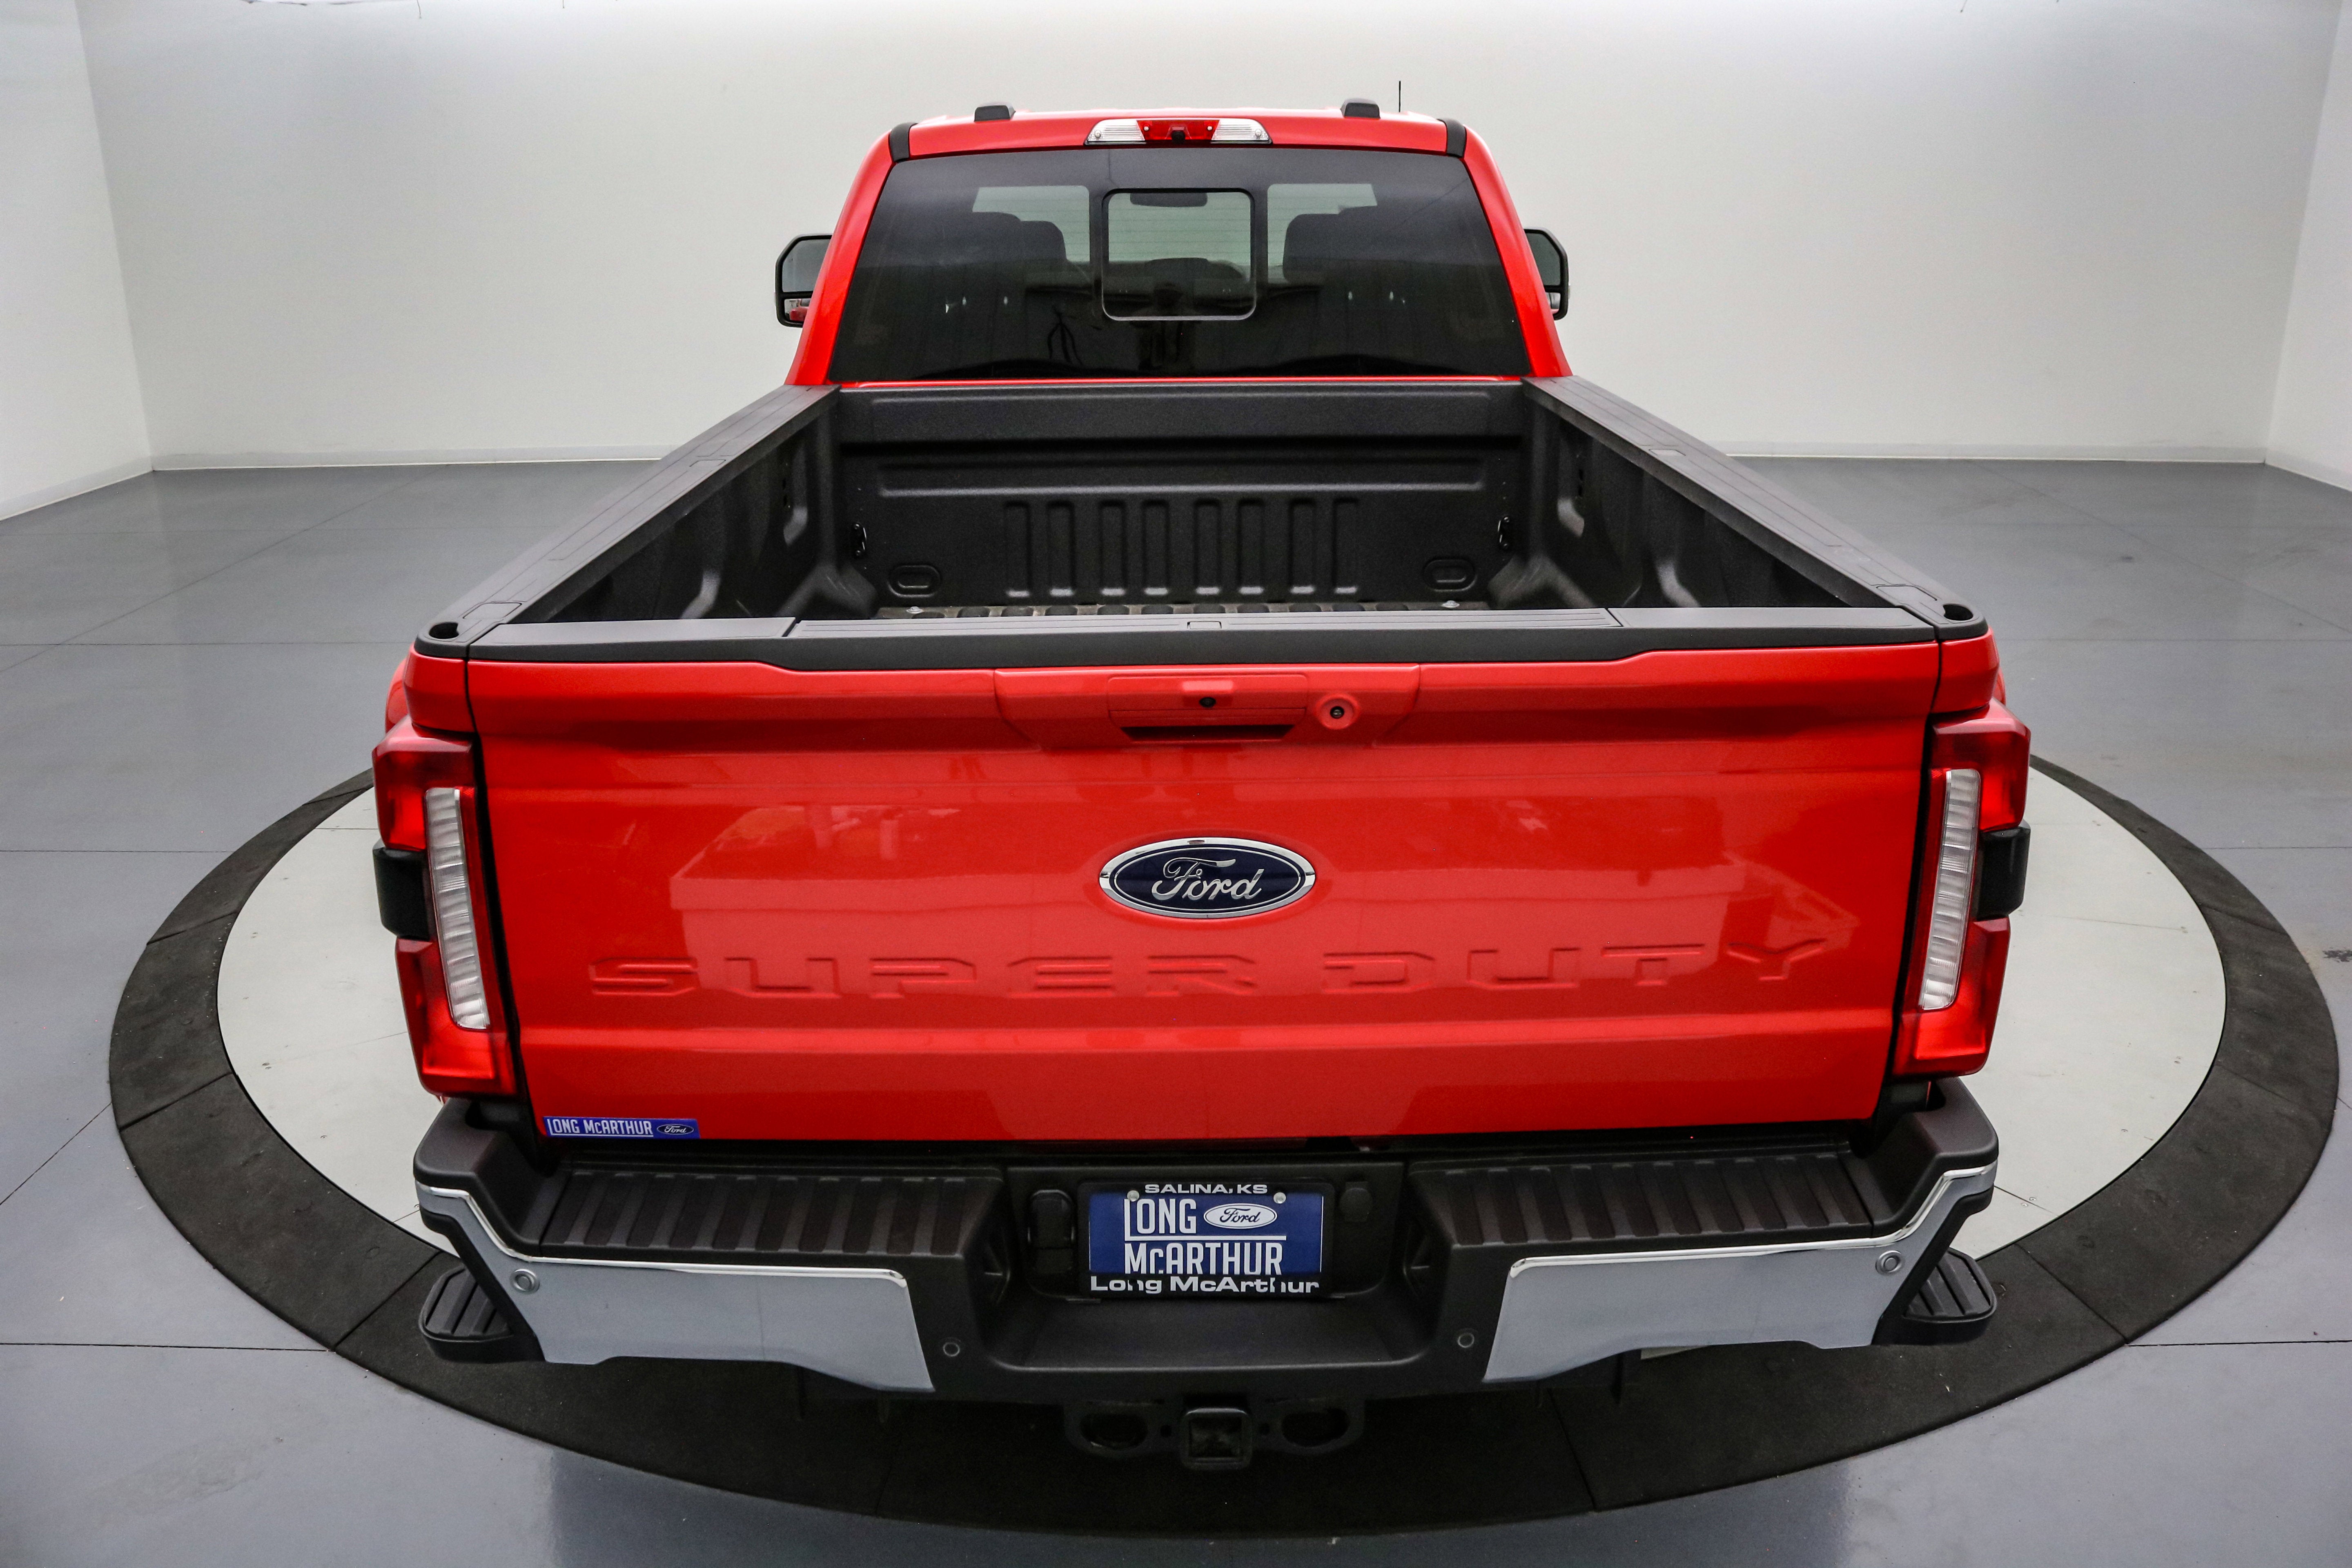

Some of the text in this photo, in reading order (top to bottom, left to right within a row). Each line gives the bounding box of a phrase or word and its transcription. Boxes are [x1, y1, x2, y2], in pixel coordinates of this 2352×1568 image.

[1152, 857, 1265, 900] Ford
[588, 938, 1827, 998] SUPER DUTY
[547, 1119, 653, 1135] LONG McARTHUR
[1237, 1185, 1267, 1193] KS
[1124, 1198, 1196, 1241] LONG
[1220, 1207, 1260, 1223] Ford
[1125, 1242, 1283, 1275] McARTHUR
[1091, 1276, 1319, 1294] Long McArthur
